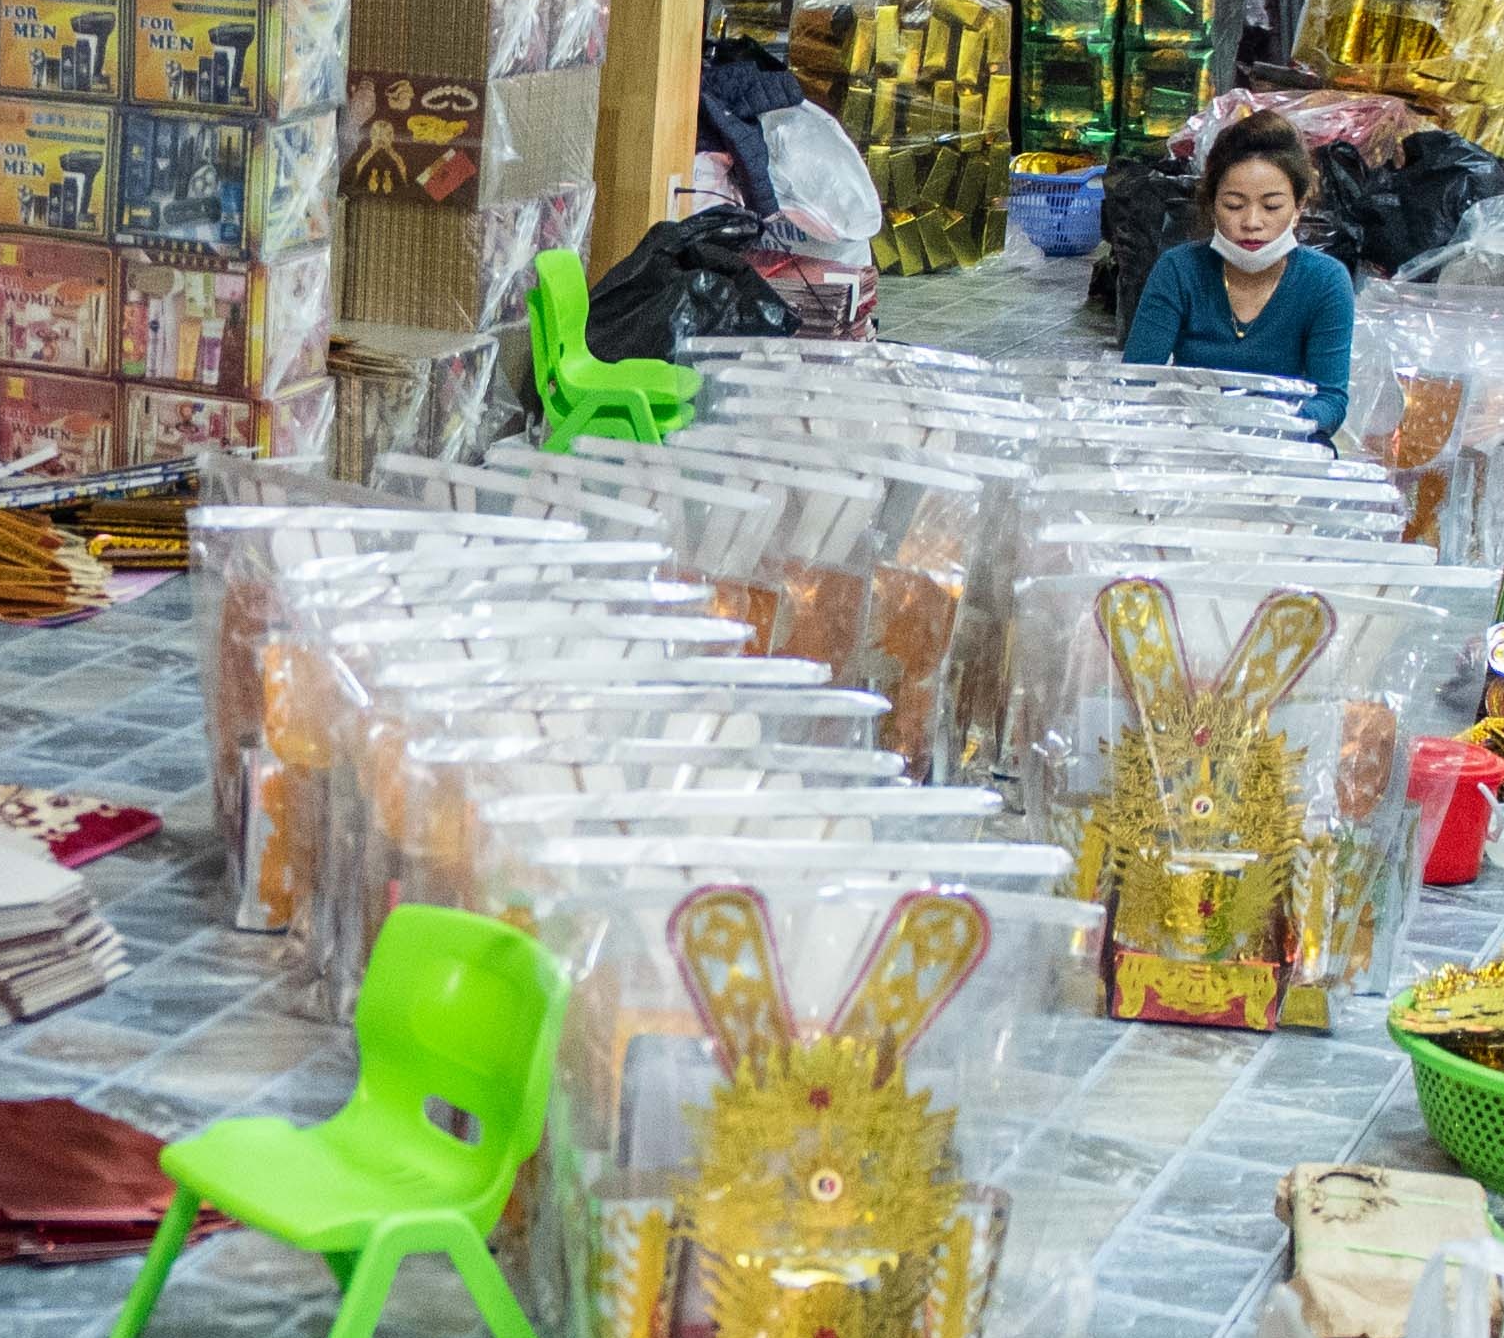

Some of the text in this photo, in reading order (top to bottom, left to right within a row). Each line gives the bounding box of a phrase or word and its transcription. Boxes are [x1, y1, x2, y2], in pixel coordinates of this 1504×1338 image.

[4, 5, 37, 20] FOR
[13, 22, 56, 40] MEN
[140, 17, 173, 31] FOR
[149, 34, 193, 51] MEN
[4, 160, 45, 177] MEN
[4, 290, 65, 307] WOMEN
[12, 423, 71, 440] WOMEN
